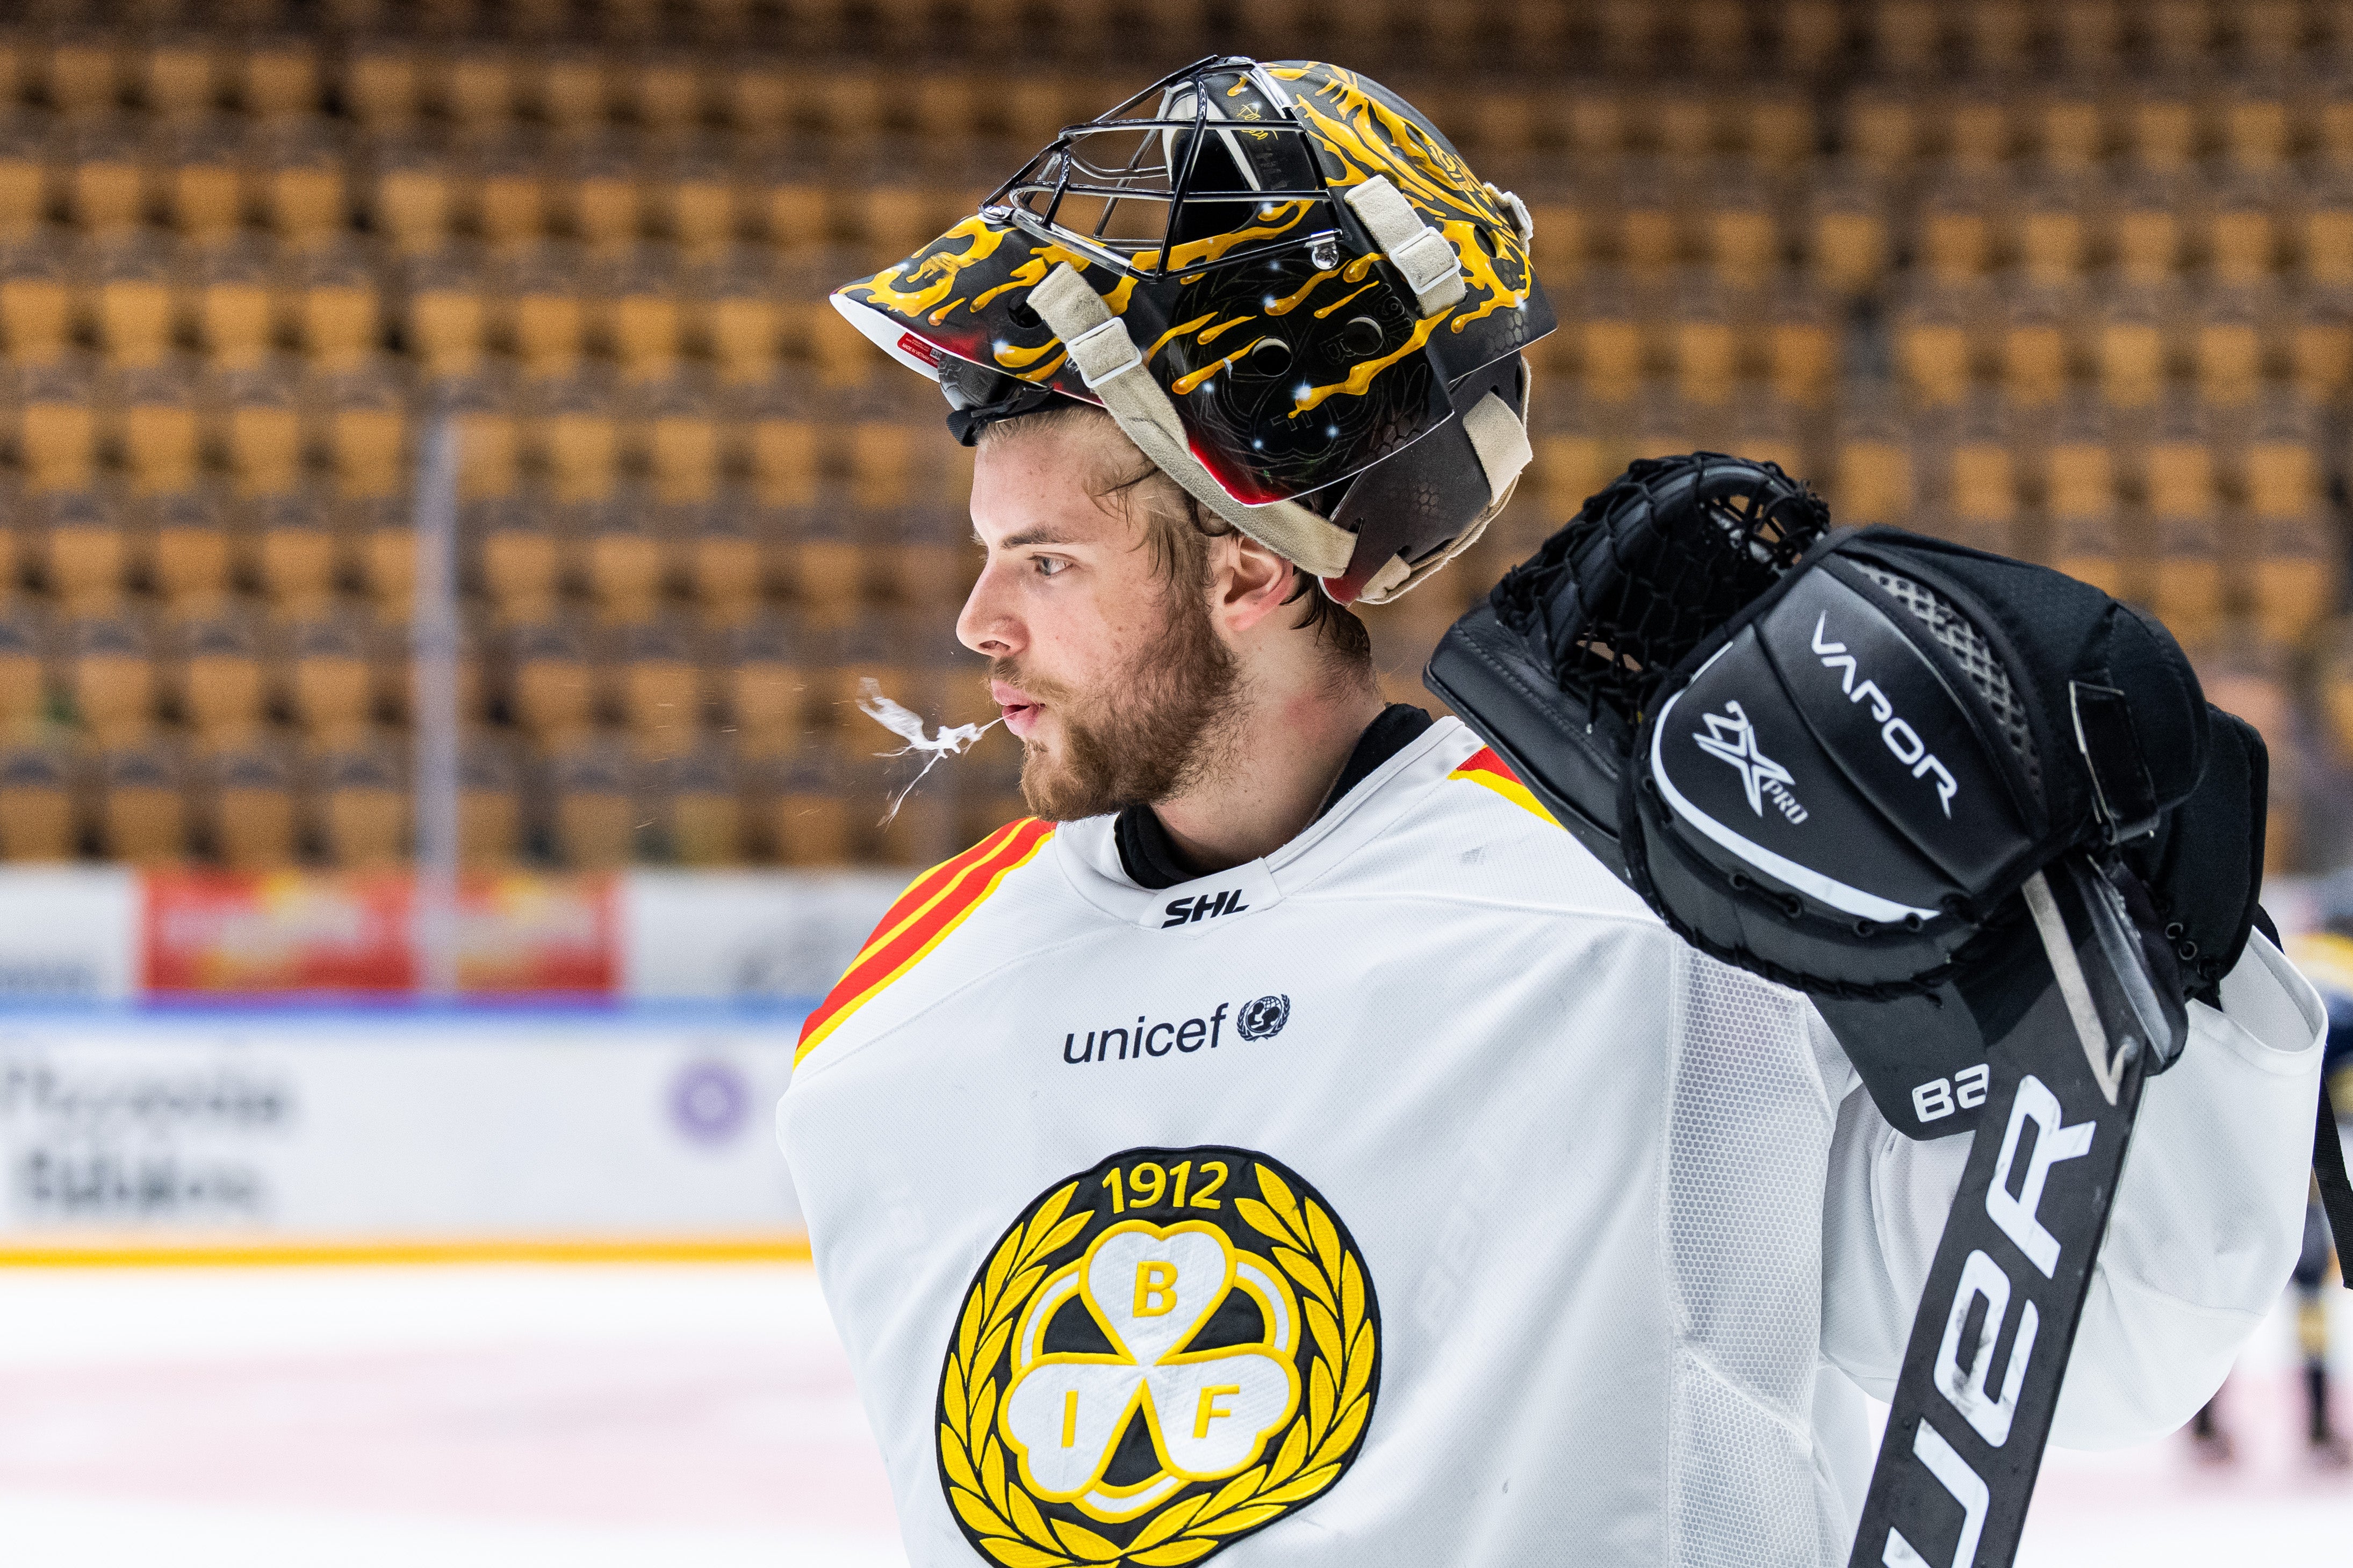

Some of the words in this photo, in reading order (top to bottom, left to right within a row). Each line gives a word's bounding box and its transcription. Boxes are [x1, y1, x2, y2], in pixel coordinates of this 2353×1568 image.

[1811, 610, 1958, 819] VAPOR
[1761, 778, 1809, 825] PRO
[1161, 889, 1250, 929] SHL
[1063, 1002, 1229, 1064] unicef
[1102, 1160, 1228, 1214] 1912
[1133, 1260, 1179, 1318] B
[1193, 1384, 1240, 1439] F
